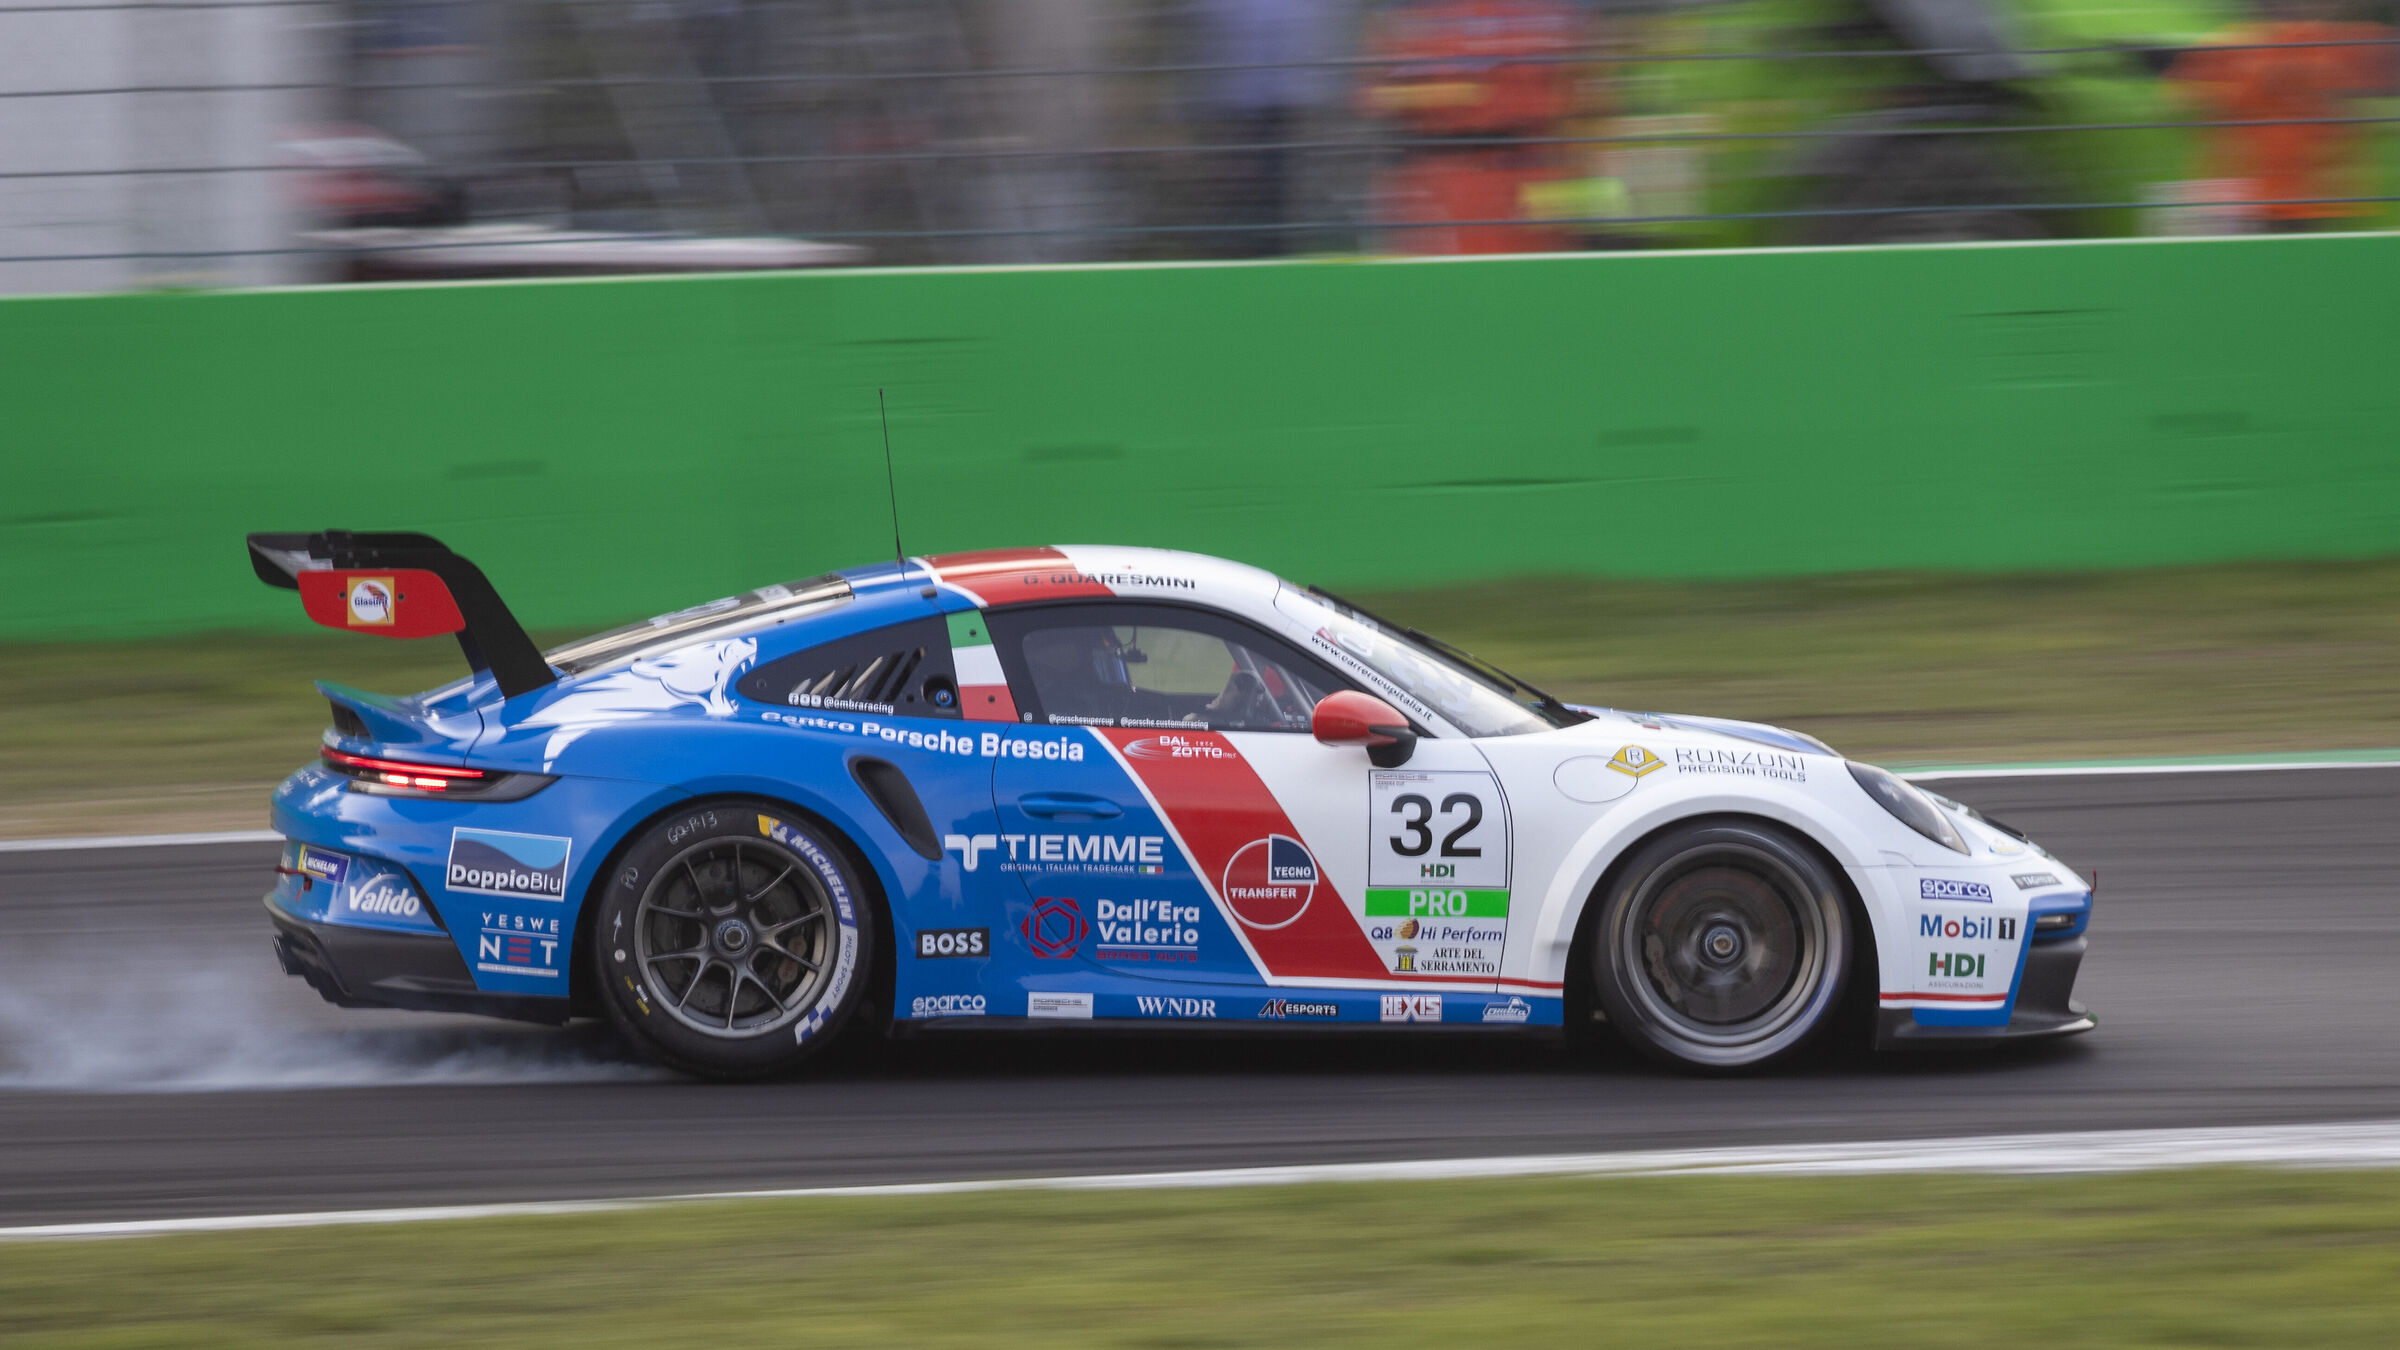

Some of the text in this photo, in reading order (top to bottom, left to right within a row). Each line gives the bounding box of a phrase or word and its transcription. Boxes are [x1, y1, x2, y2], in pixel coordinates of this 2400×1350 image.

[1051, 573, 1196, 590] QUARESMINI
[761, 710, 1085, 763] Centro Porsche Brescia
[1160, 735, 1189, 746] DAL
[1172, 746, 1223, 758] ZOTTO
[1676, 748, 1805, 771] RONZONI
[1679, 764, 1806, 783] PRECISION TOOLS
[1389, 792, 1483, 858] 32
[1001, 834, 1164, 864] TIEMME
[307, 857, 338, 875] MICHELIN
[790, 834, 854, 921] MICHELIN
[1000, 863, 1135, 874] ORIGINAL ITALIAN TRADEMARK
[1273, 866, 1312, 879] TECNO
[1420, 863, 1455, 878] HDI
[451, 864, 561, 894] DoppioBlu
[1921, 880, 1990, 900] sparco
[348, 882, 420, 917] Valido
[1230, 887, 1297, 899] TRANSFER
[1409, 889, 1468, 917] PRO
[1097, 899, 1200, 922] Dall'Era
[1097, 921, 1199, 945] Valerio
[1371, 926, 1502, 943] Q8 Hi Perform
[1921, 914, 1992, 939] Mobil
[479, 934, 559, 966] NET
[921, 930, 983, 955] BOSS
[1432, 947, 1485, 960] ARTE DEL
[1096, 950, 1198, 963] BRASS NUTS
[1421, 960, 1495, 974] SERRAMENTO
[1928, 952, 1985, 978] HDI
[912, 994, 986, 1017] sparco
[1381, 995, 1441, 1022] HEXIS
